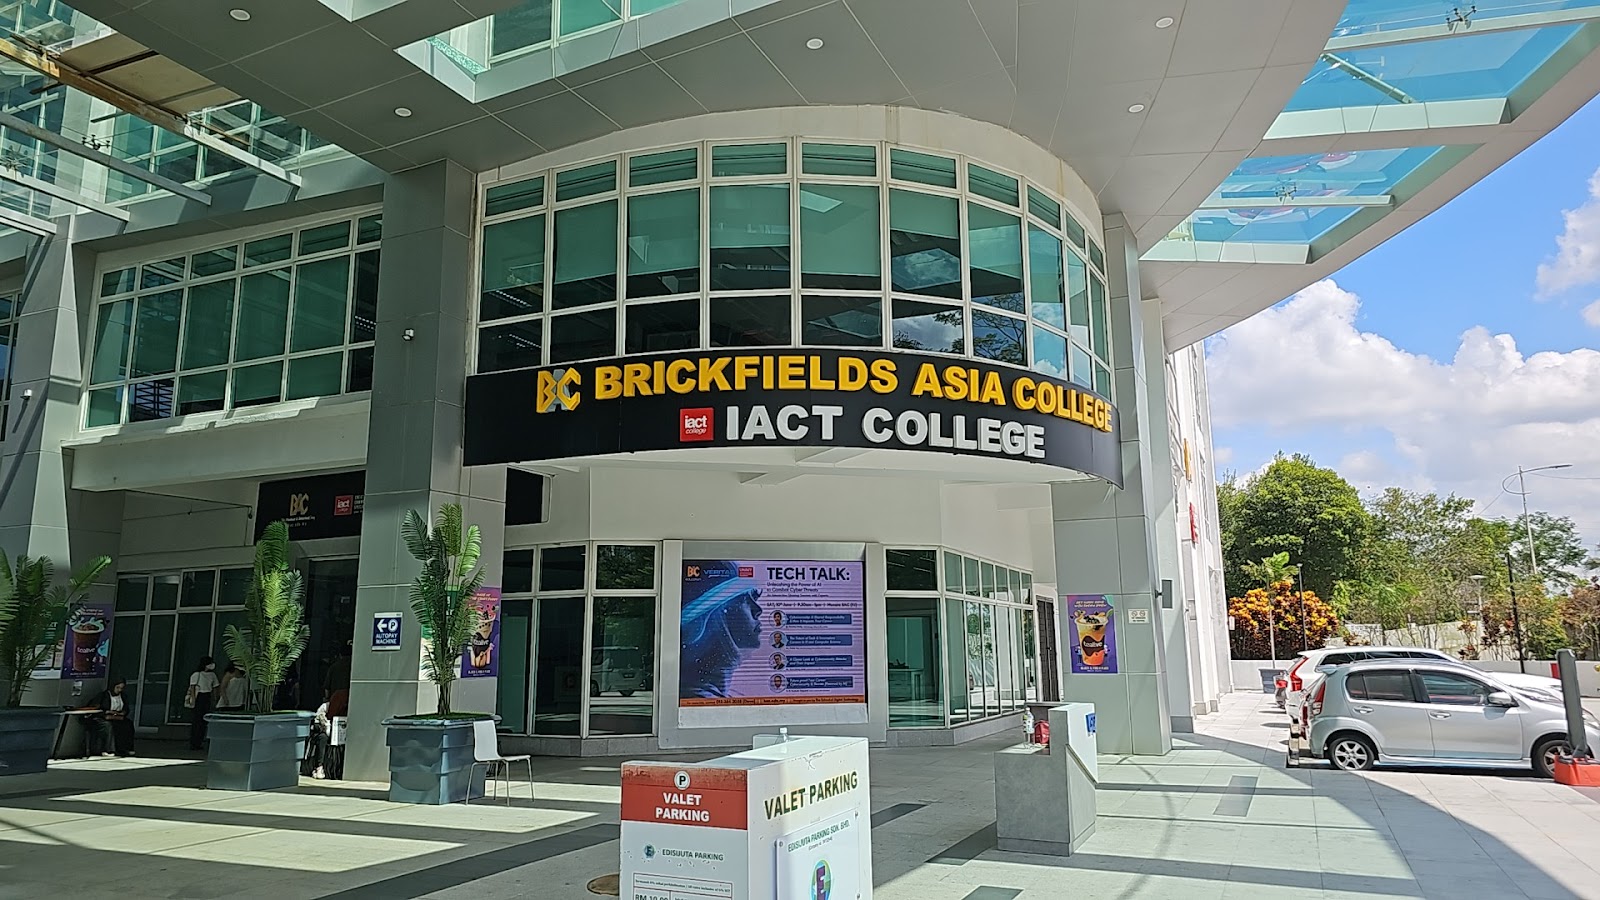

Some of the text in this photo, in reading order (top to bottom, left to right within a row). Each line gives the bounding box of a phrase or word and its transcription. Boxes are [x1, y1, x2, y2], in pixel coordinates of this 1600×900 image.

[595, 355, 1113, 433] BRICKFIELDS ASIA COLLEGE
[685, 415, 707, 428] iact
[726, 405, 1046, 458] IACT COLLEGE
[766, 567, 806, 580] TECH
[809, 567, 850, 580] TALK:
[679, 775, 686, 785] P
[663, 792, 702, 805] VALET
[764, 771, 858, 820] VALET PARKING
[655, 807, 710, 821] PARKING
[811, 827, 830, 842] PARKING
[694, 851, 724, 861] PARKING
